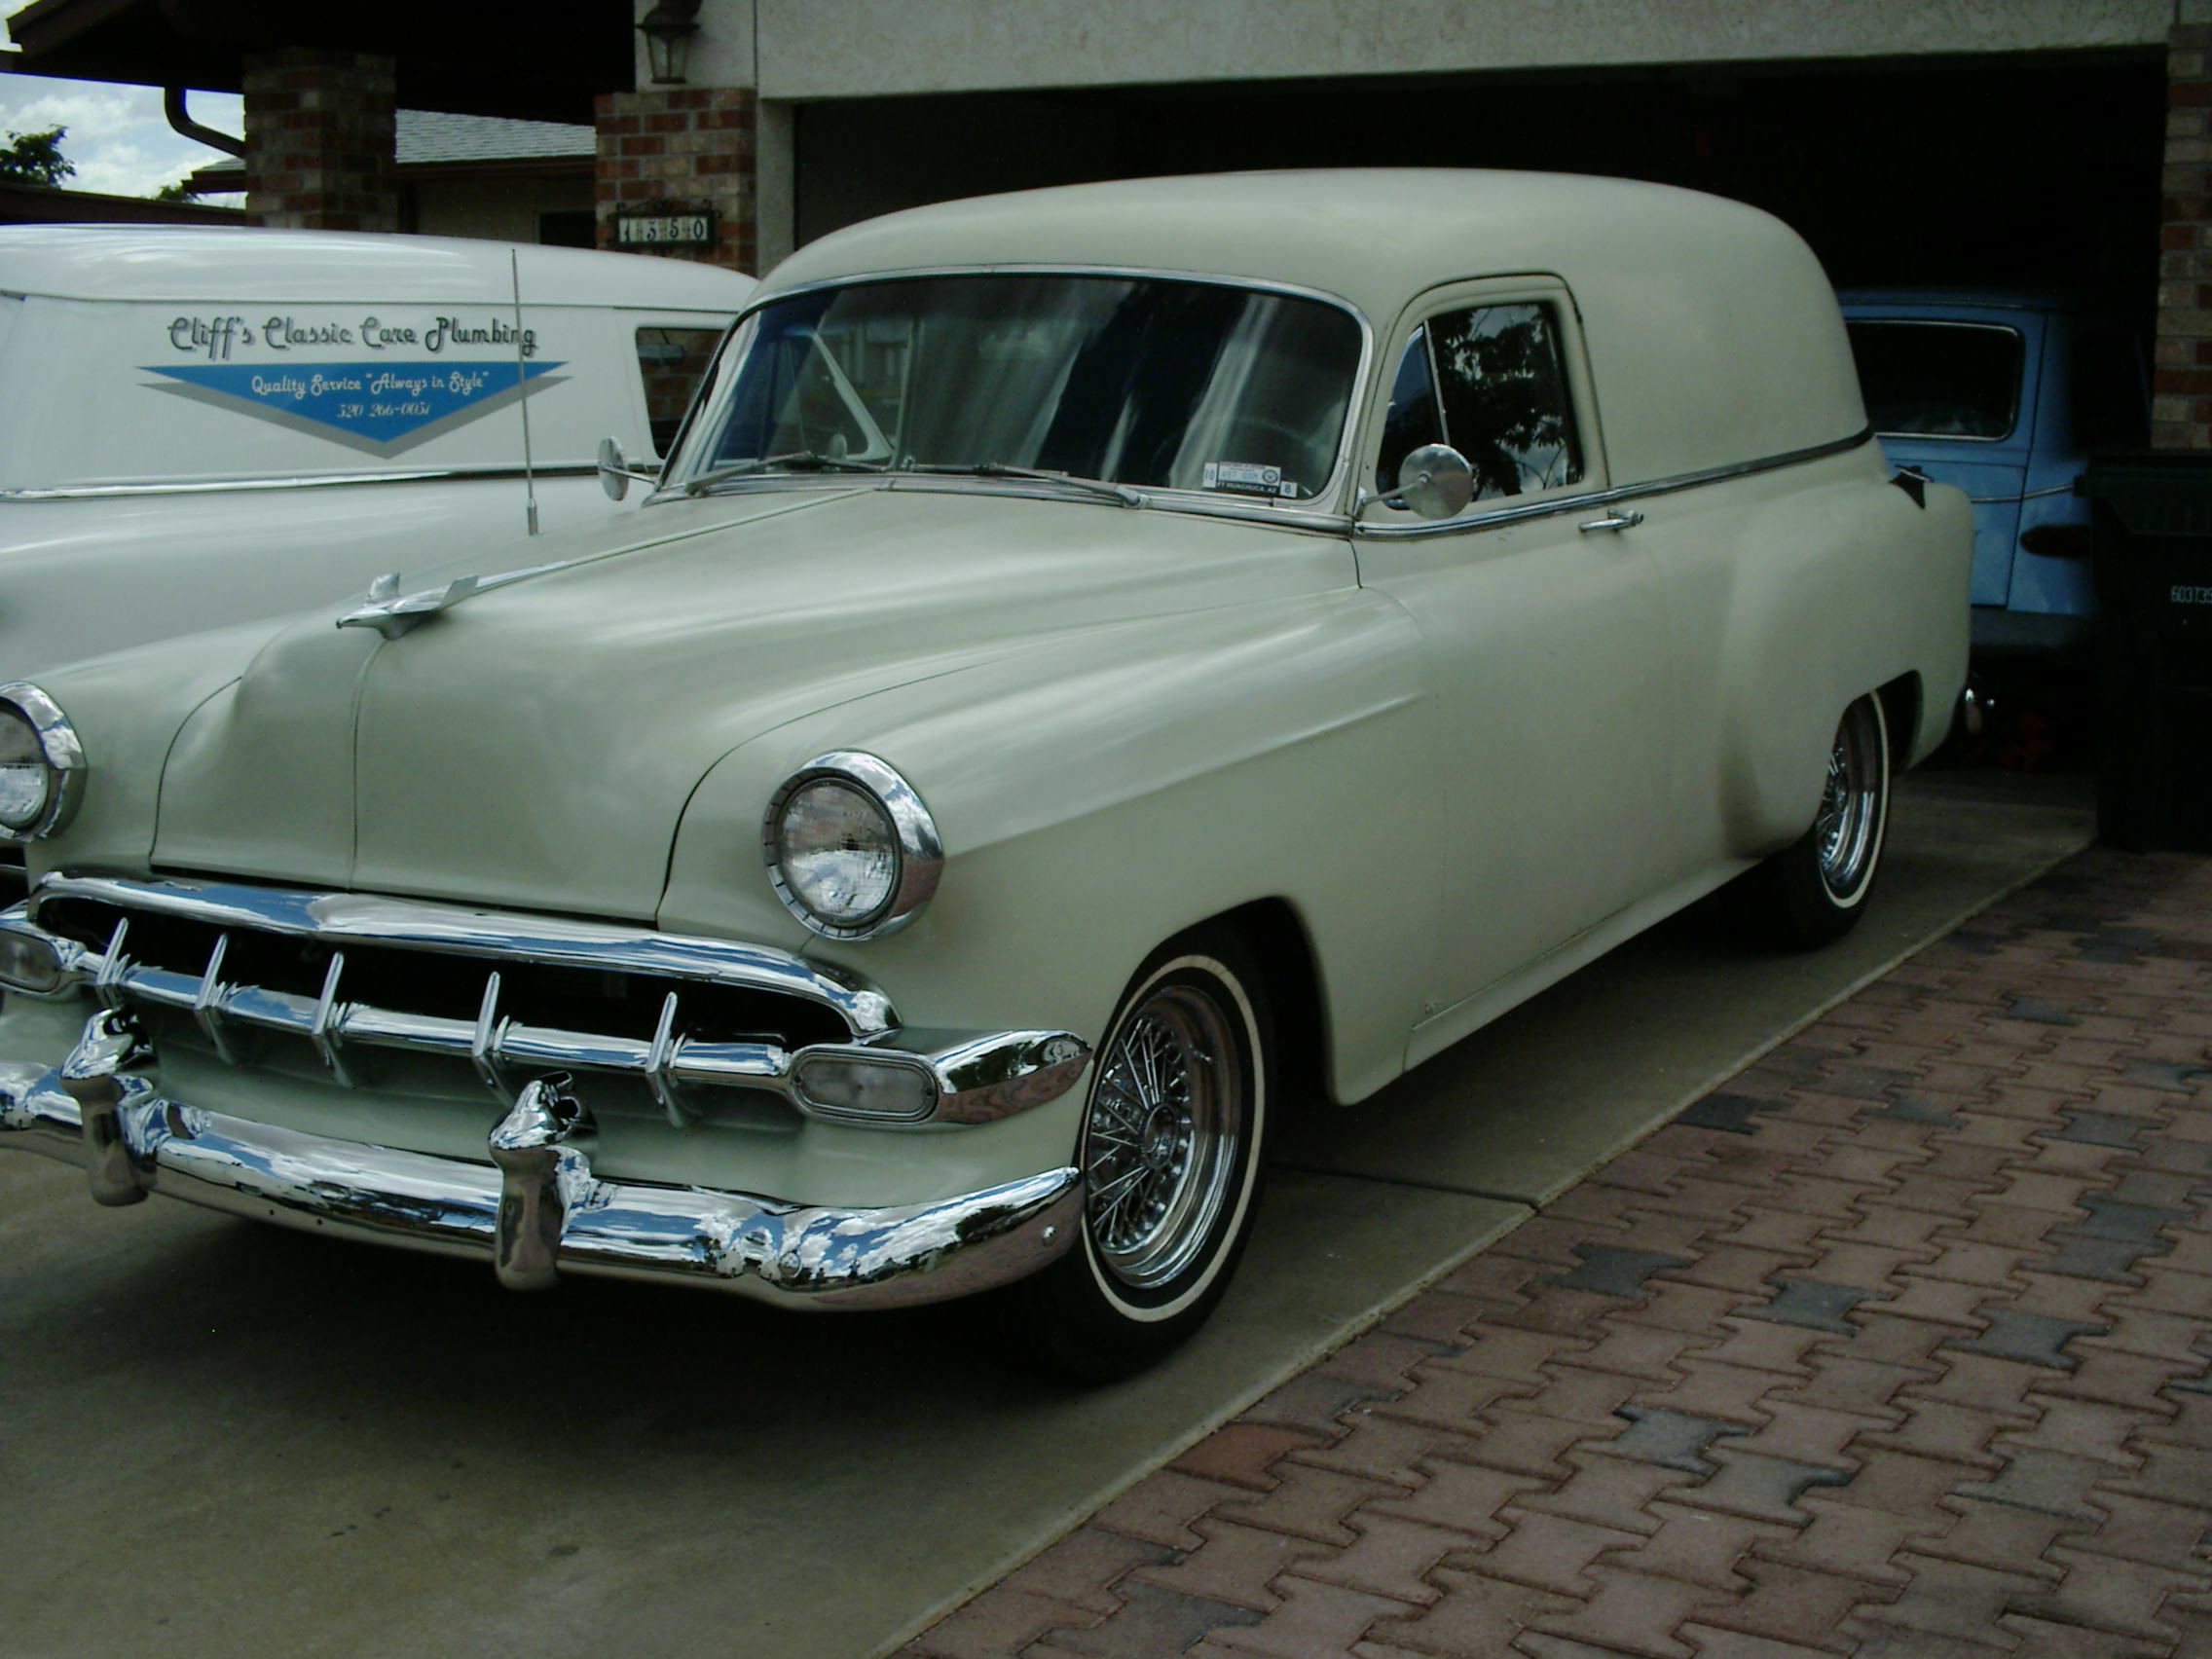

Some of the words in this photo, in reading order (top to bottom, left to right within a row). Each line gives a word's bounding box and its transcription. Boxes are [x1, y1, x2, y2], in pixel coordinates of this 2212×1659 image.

[167, 316, 253, 360] Cliff's
[262, 316, 353, 349] Classic
[359, 316, 417, 349] Care
[424, 316, 538, 357] Plumbing
[251, 375, 306, 400] Quality
[311, 374, 362, 396] Service
[366, 372, 427, 396] "Always
[431, 376, 445, 388] in
[449, 371, 489, 395] Style"
[337, 404, 363, 418] 520
